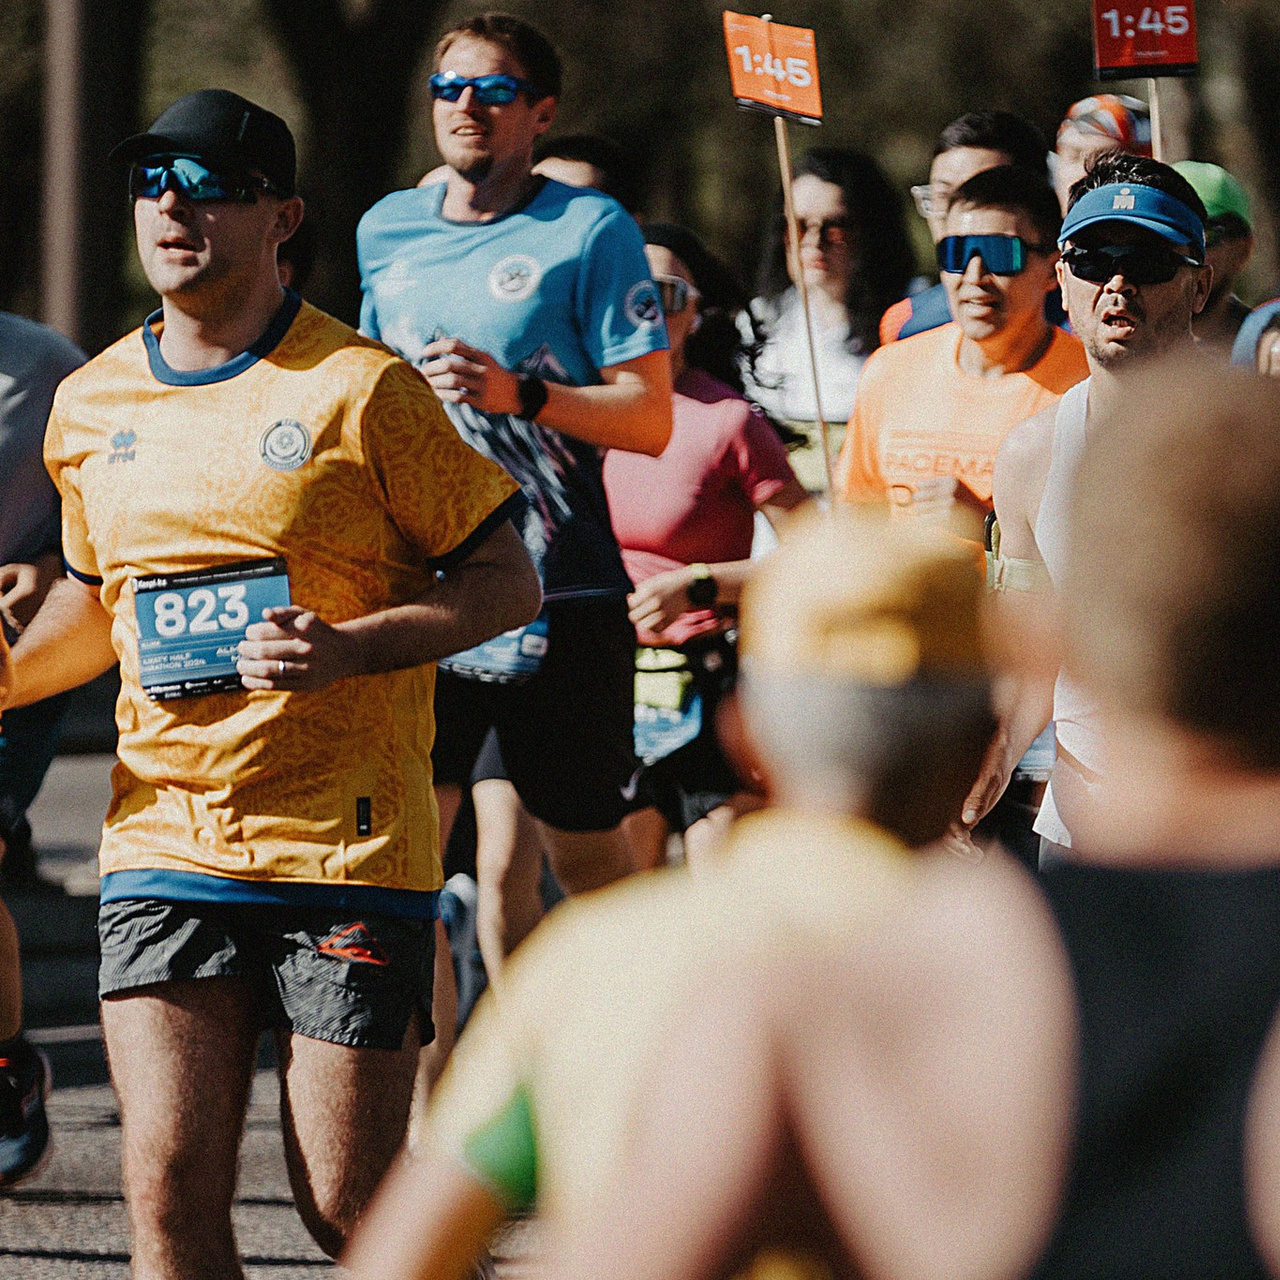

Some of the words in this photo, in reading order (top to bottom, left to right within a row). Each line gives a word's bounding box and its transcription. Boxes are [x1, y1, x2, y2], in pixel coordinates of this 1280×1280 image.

[1101, 6, 1189, 37] 1:45
[734, 45, 812, 87] 1:45
[154, 584, 249, 637] 823
